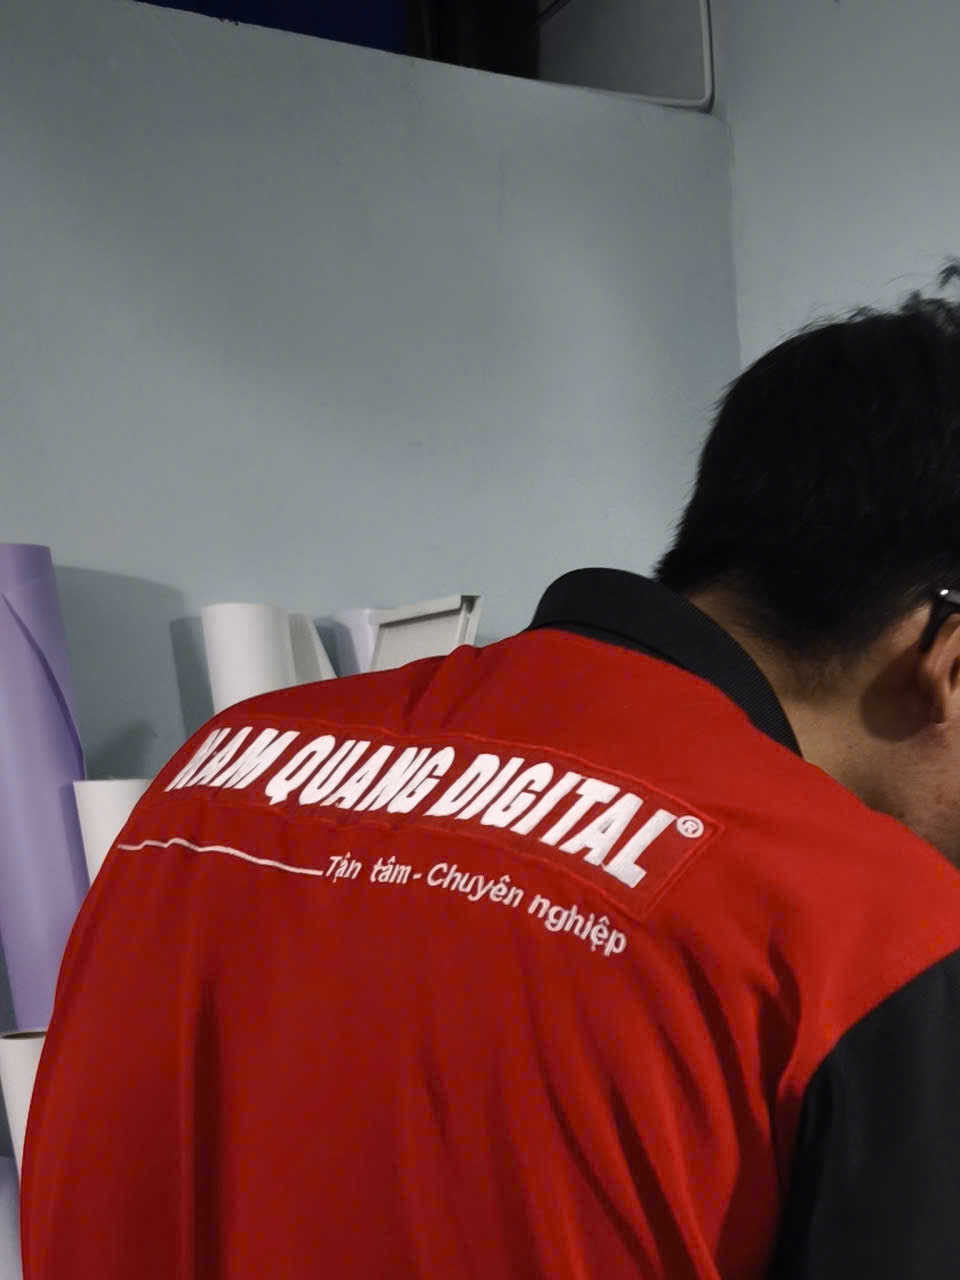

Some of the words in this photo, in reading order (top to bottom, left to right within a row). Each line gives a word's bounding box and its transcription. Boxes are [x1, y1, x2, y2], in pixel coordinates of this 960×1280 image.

[164, 725, 301, 793] NAM
[264, 734, 455, 814] QUANG
[426, 862, 525, 908] Chuyên
[527, 893, 628, 957] nghiệp
